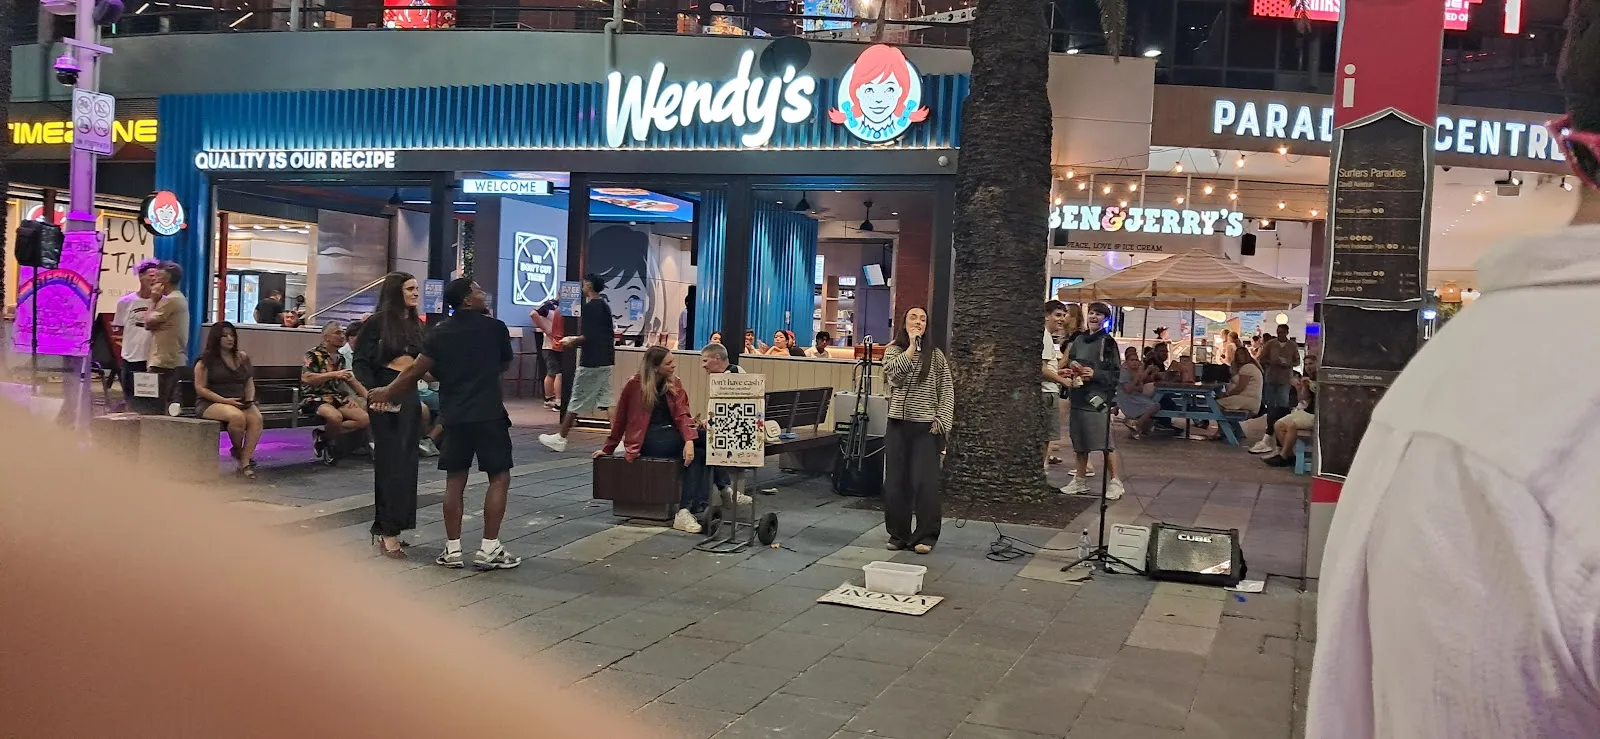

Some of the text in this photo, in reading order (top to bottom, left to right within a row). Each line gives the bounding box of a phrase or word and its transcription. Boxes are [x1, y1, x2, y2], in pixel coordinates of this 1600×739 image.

[606, 49, 815, 147] Wendy's
[1213, 100, 1335, 142] PARAD
[8, 119, 157, 144] IMENE
[195, 151, 395, 169] QUALITY IS OUR RECIPE
[1339, 168, 1407, 178] Surfers Paradise
[474, 181, 537, 192] WELCOME
[1092, 242, 1113, 250] LOVE
[1122, 243, 1134, 251] ICE
[1136, 244, 1163, 252] CREAM
[1178, 533, 1213, 543] CUBE
